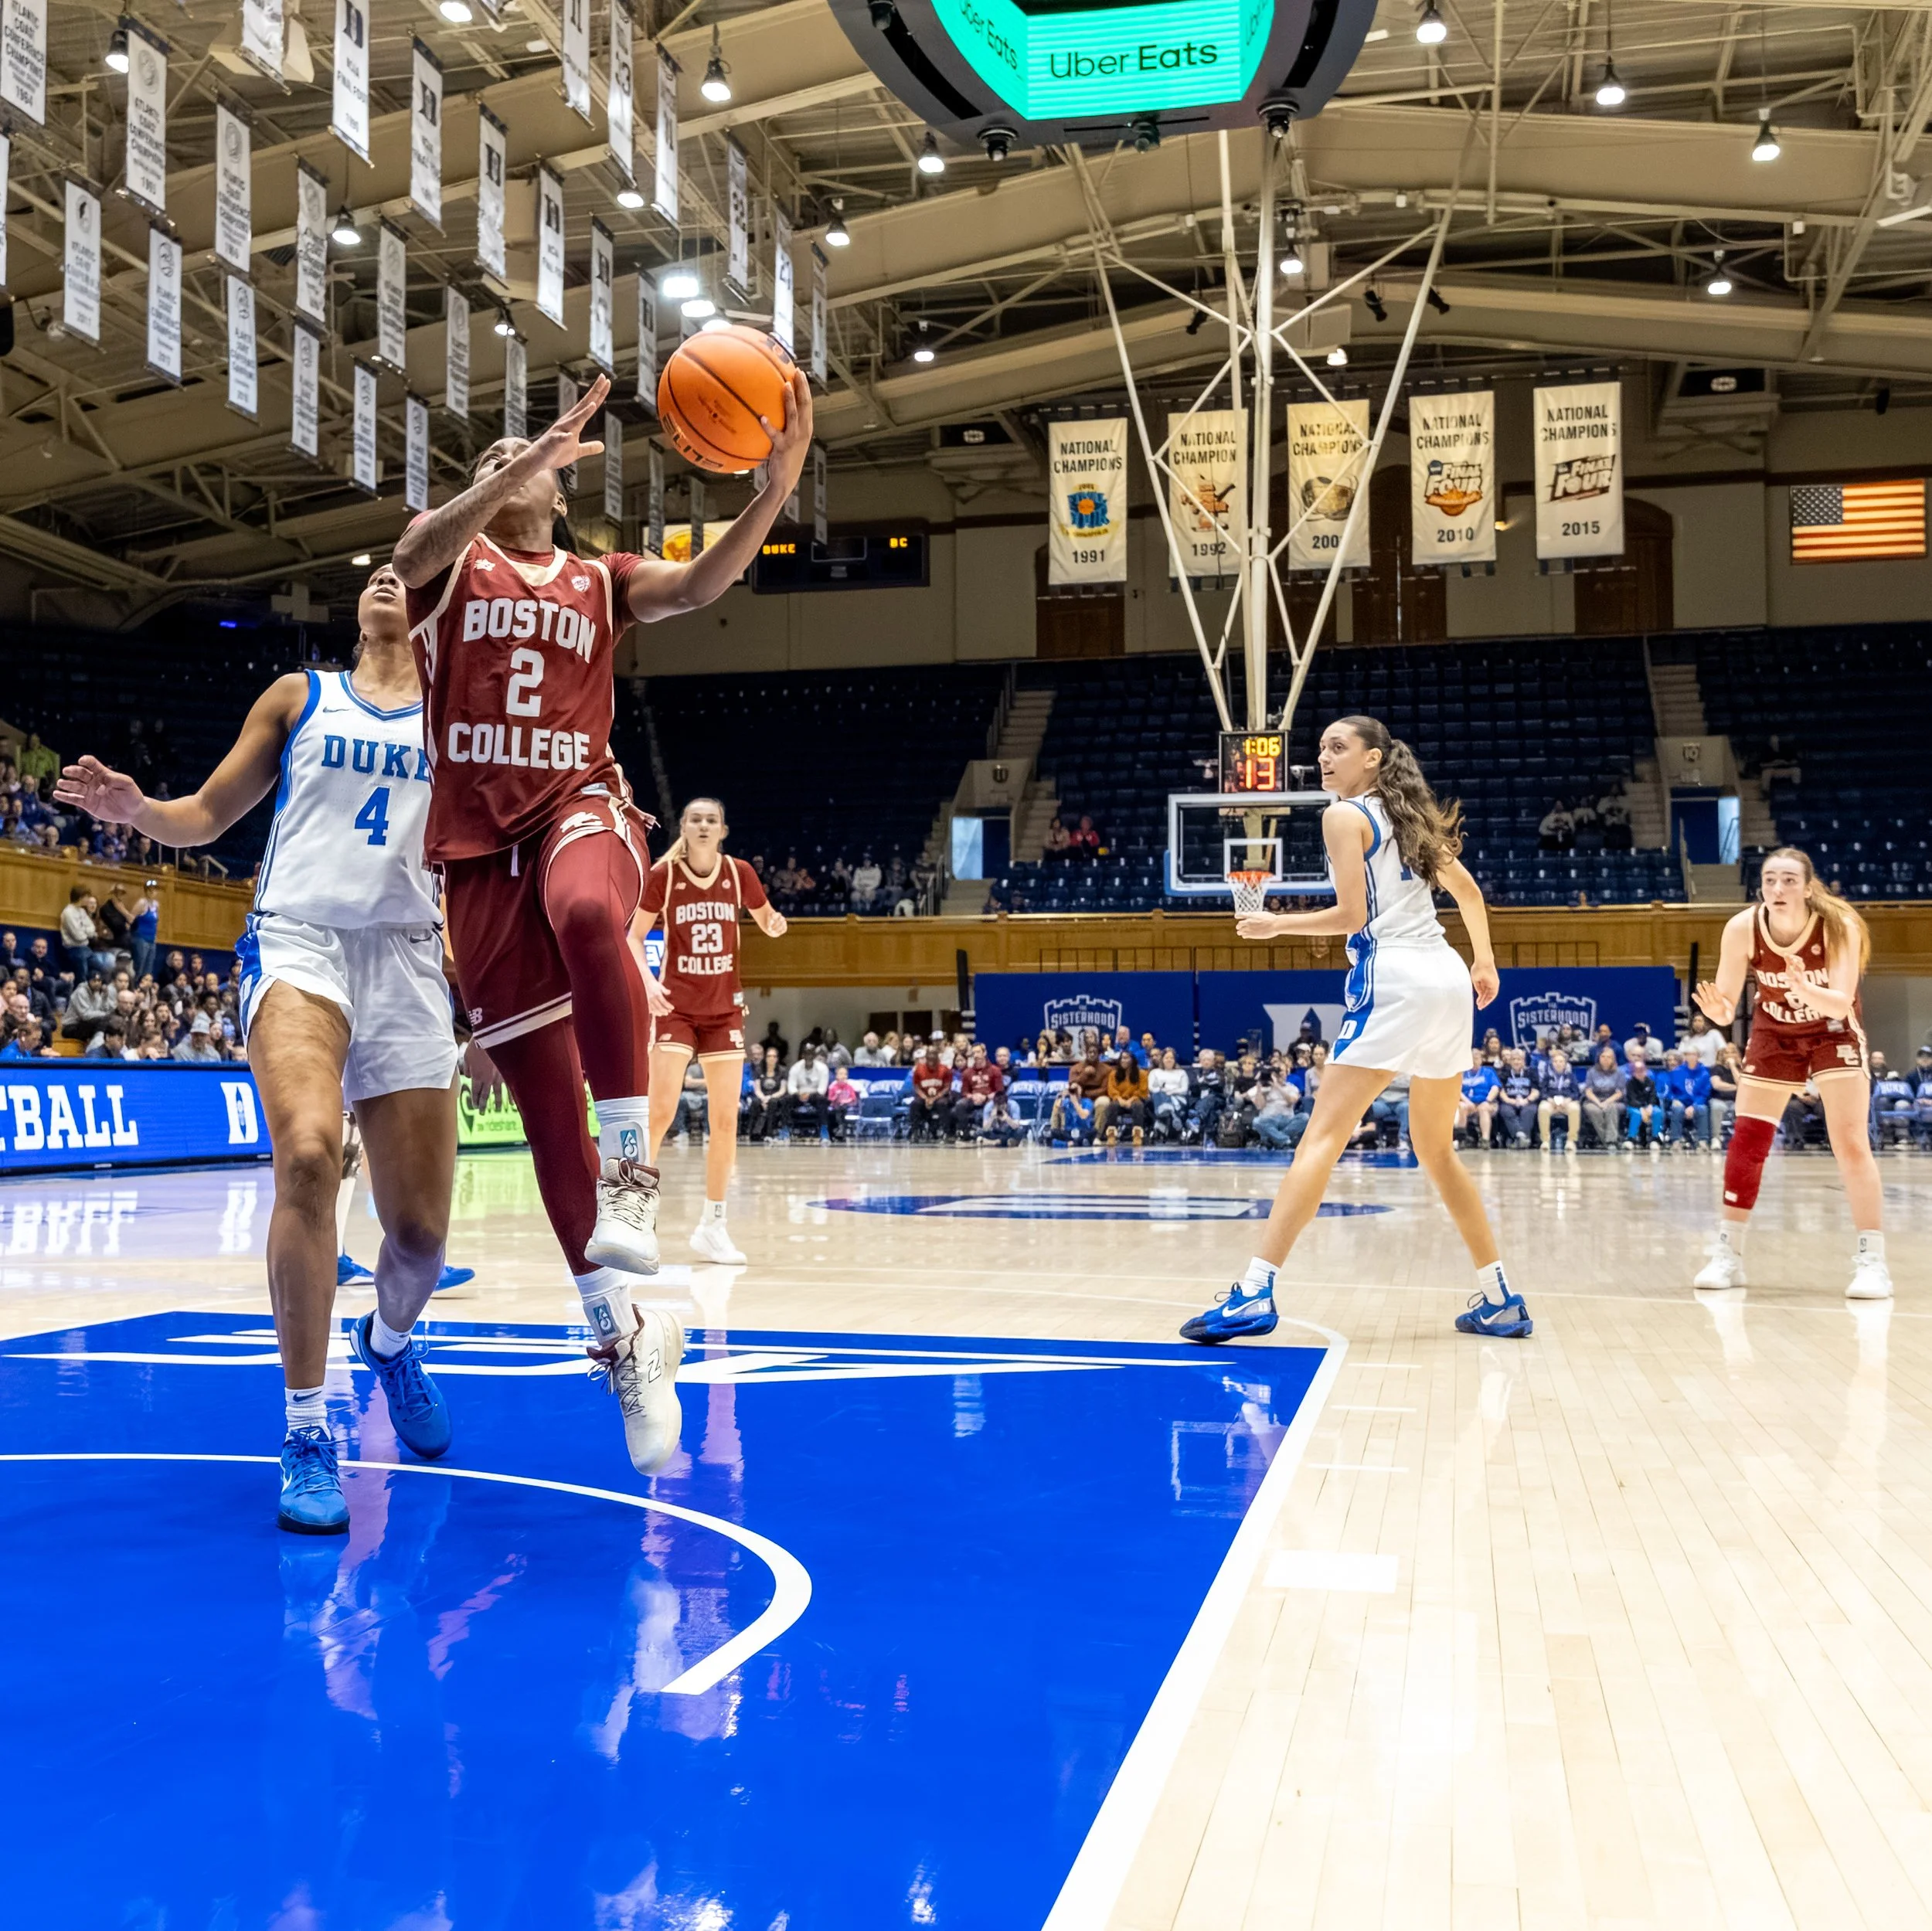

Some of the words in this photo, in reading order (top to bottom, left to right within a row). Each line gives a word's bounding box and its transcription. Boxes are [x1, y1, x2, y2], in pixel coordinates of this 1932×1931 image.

[987, 19, 1018, 70] Eats
[1050, 52, 1130, 78] Uber
[1138, 42, 1218, 71] Eats
[1422, 414, 1482, 430] NATIONAL
[1547, 404, 1608, 422] NATIONAL
[1180, 431, 1237, 447] NATIONAL
[1417, 431, 1489, 450] CHAMPIONS
[1543, 423, 1617, 441] CHAMPIONS
[1060, 439, 1117, 455] NATIONAL
[1053, 457, 1123, 474] CHAMPIONS
[1173, 449, 1237, 465] CHAMPION
[1555, 469, 1611, 497] FOUR
[1437, 527, 1475, 542] 2010
[1562, 521, 1600, 536] 2015
[1192, 542, 1226, 556] 1992
[1312, 535, 1342, 549] 200
[1072, 549, 1105, 563] 1991
[464, 598, 596, 664] BOSTON
[506, 648, 545, 717] 2
[447, 722, 590, 770] COLLEGE
[1243, 737, 1281, 756] 1:06
[354, 787, 390, 845] 4
[675, 902, 735, 925] BOSTON
[692, 923, 723, 954] 23
[678, 954, 733, 975] COLLEGE
[1756, 967, 1829, 988] BOSON
[1051, 1011, 1115, 1029] SISTERHOOD
[1518, 1008, 1589, 1029] SISTERHOOD
[1762, 1001, 1821, 1024] COLLEG
